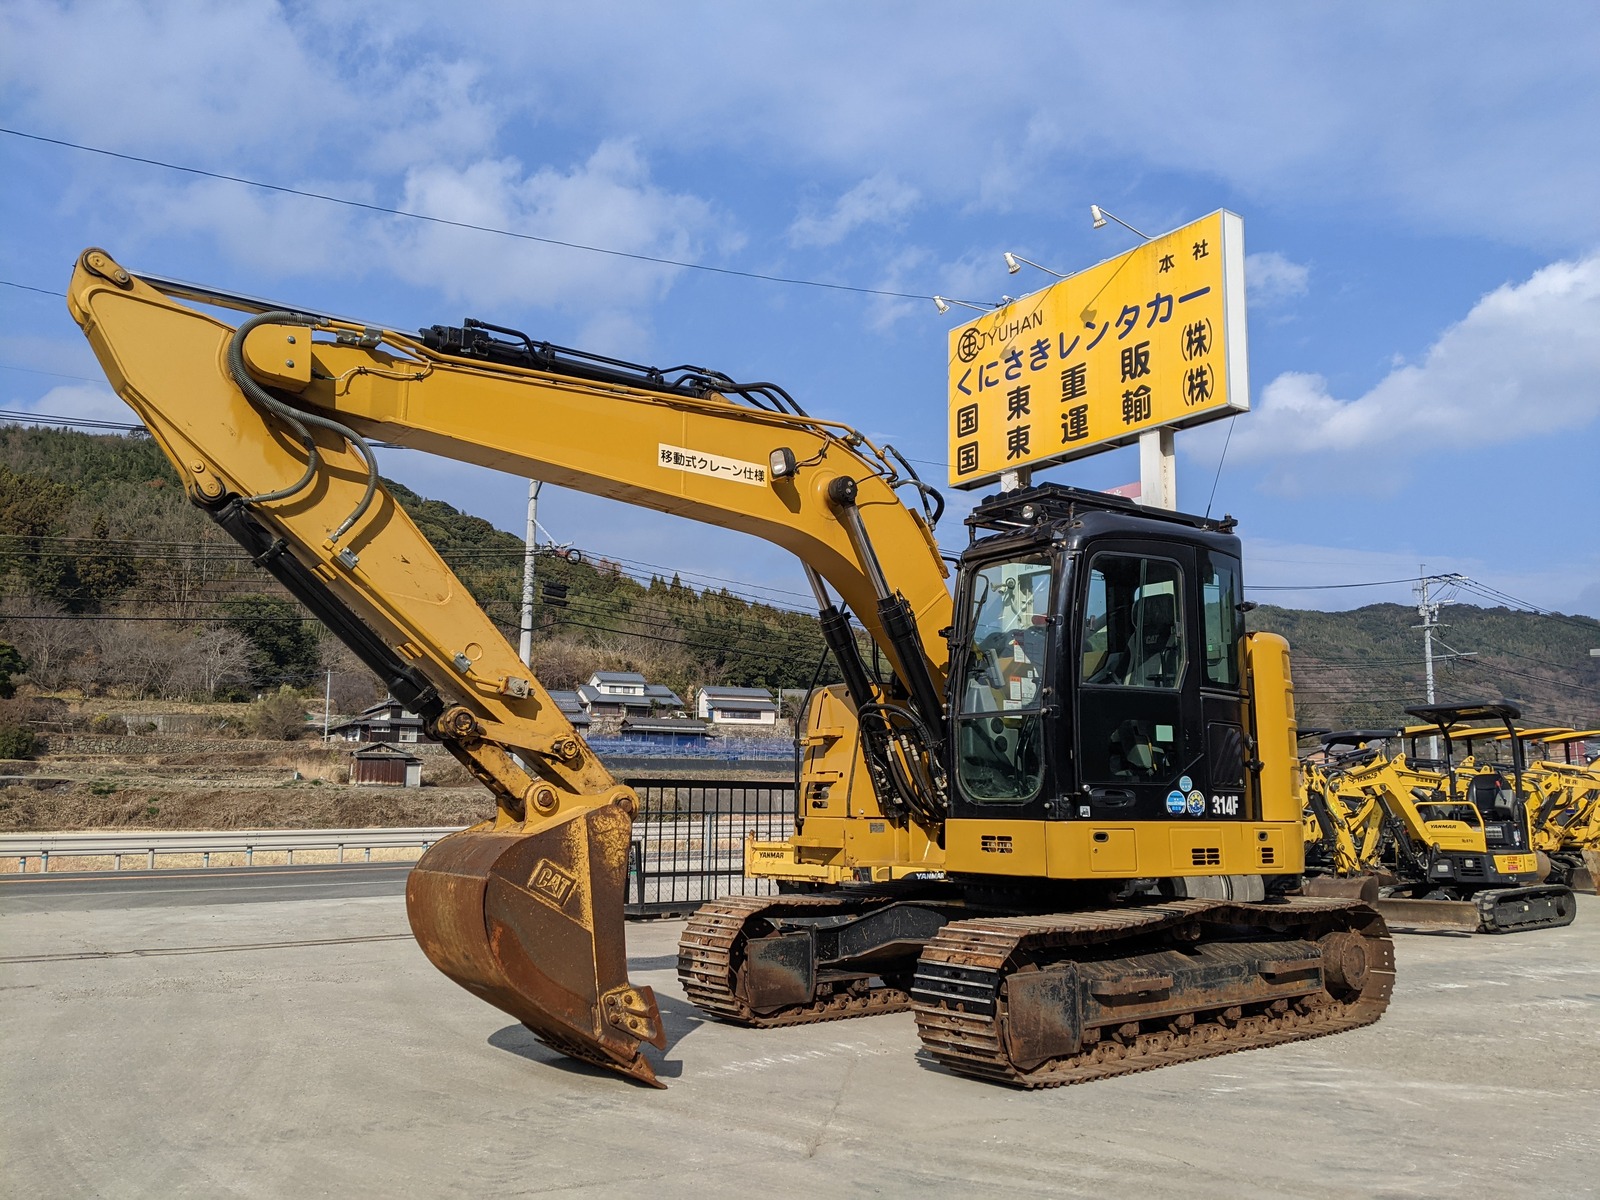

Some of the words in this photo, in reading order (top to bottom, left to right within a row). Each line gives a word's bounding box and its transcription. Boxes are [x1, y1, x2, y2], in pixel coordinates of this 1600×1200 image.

[1158, 239, 1210, 274] 本社
[957, 286, 1211, 396] くにさきレンタカー
[977, 310, 1043, 350] JYUHAN
[660, 449, 765, 482] 移動式クレーン仕様
[1212, 795, 1239, 815] 314F
[759, 851, 784, 859] YANMAR
[536, 868, 571, 899] CAT
[916, 872, 945, 880] YANMAR
